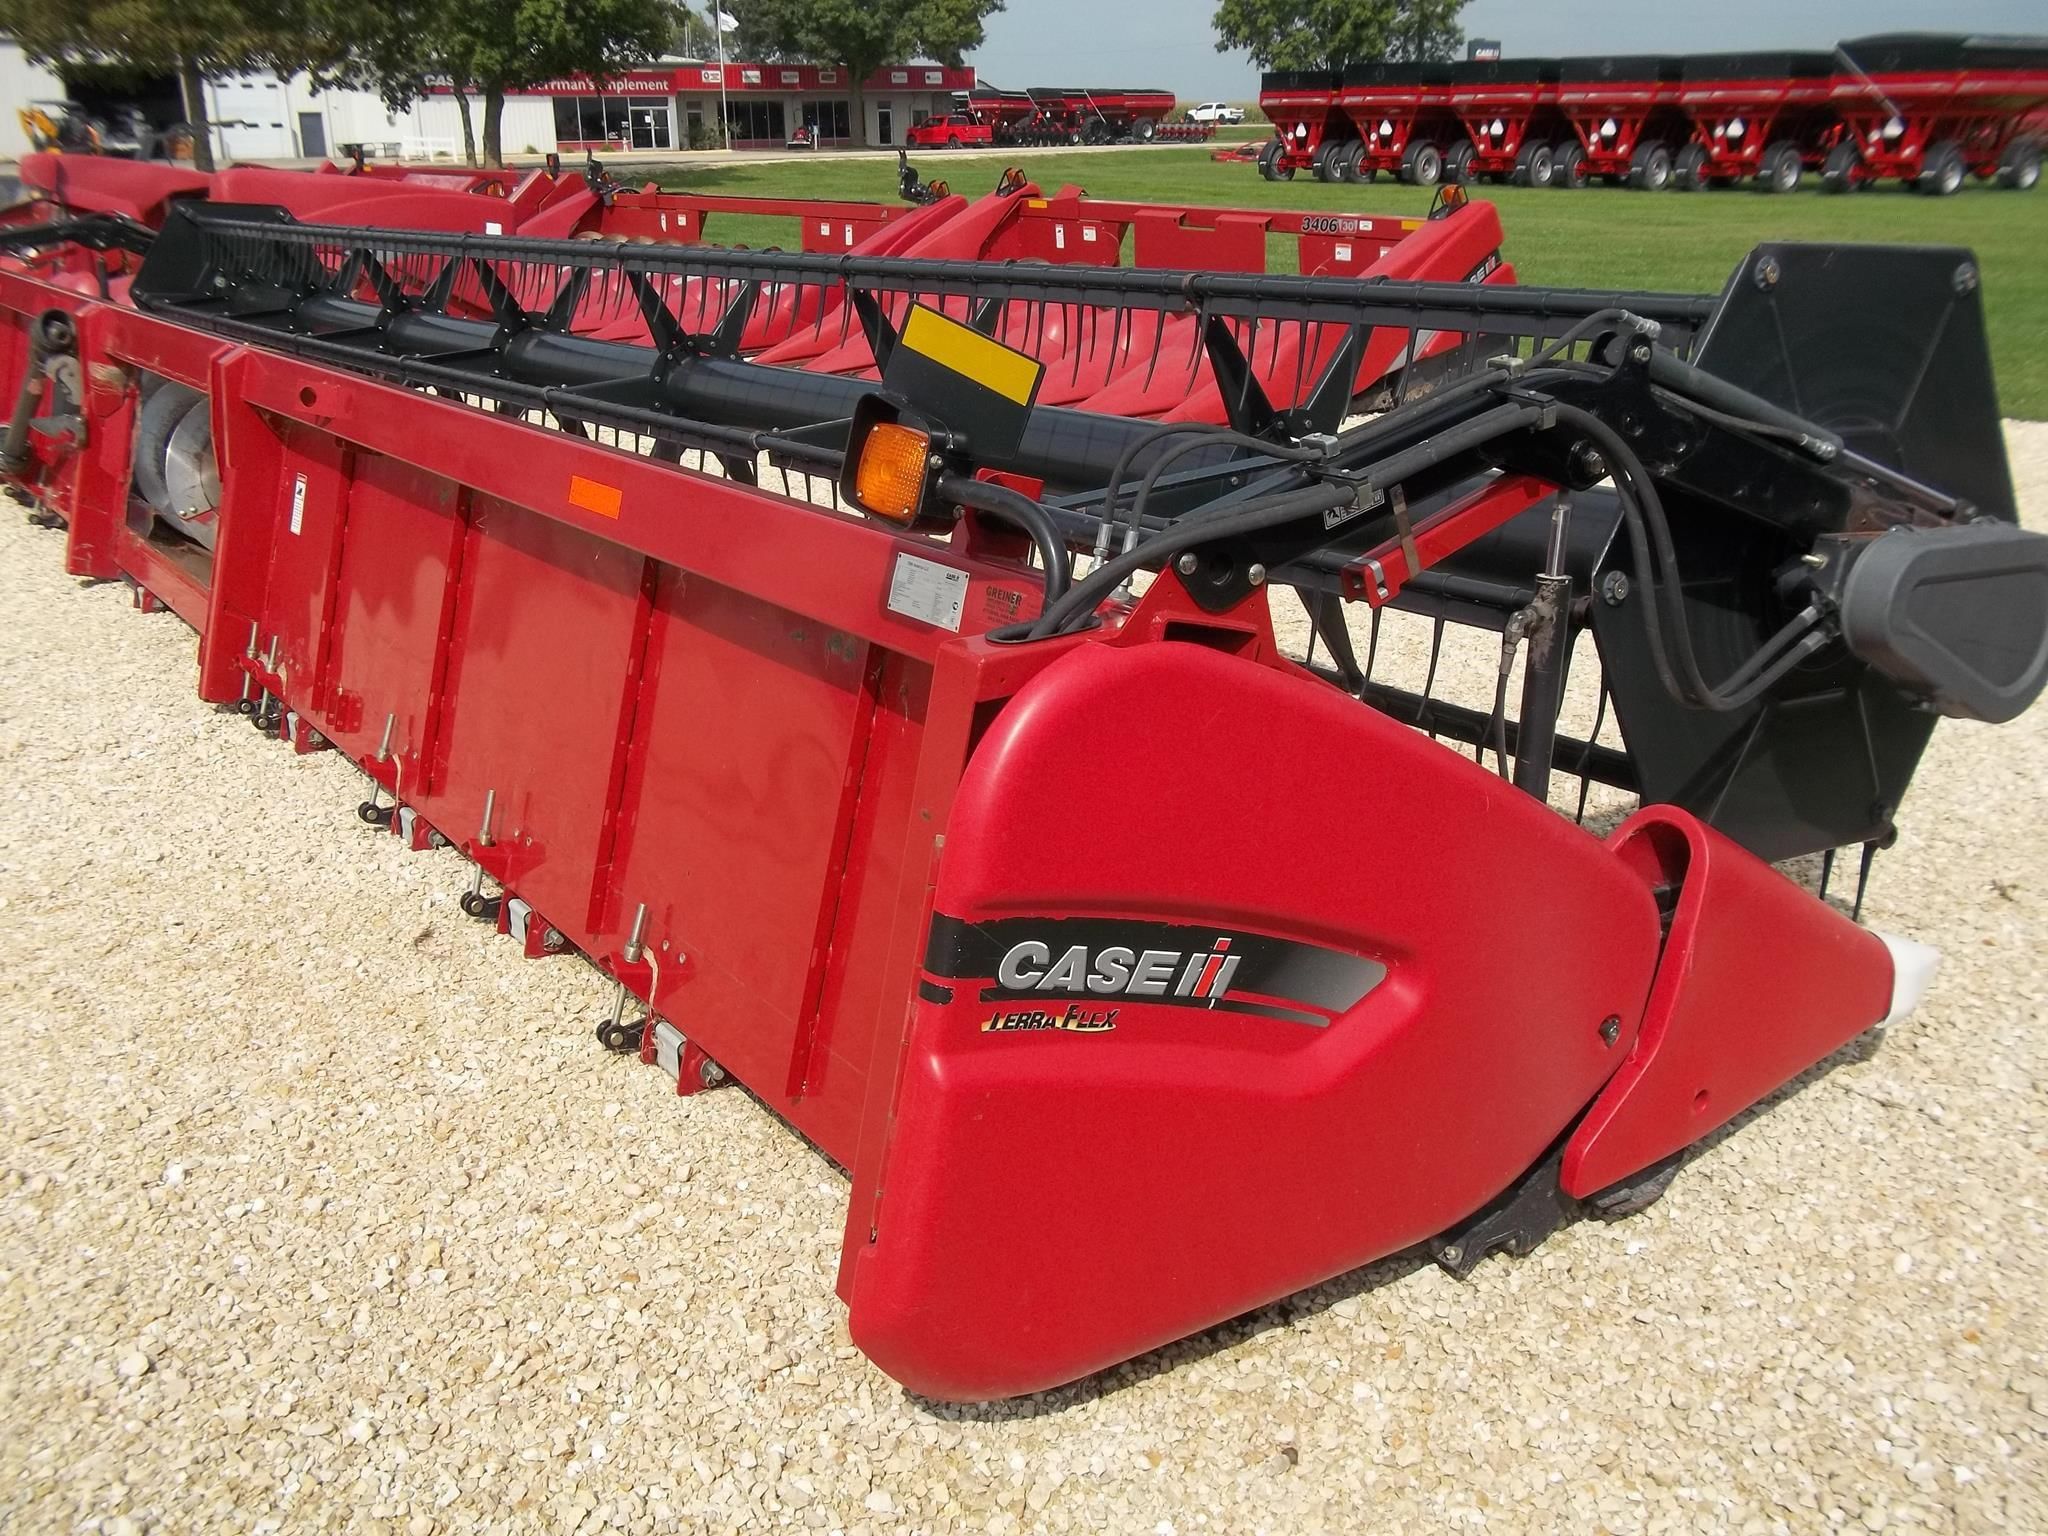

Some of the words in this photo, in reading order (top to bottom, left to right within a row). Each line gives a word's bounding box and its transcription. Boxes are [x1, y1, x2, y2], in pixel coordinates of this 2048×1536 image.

[424, 73, 455, 87] CAS
[528, 78, 595, 91] errman's
[1302, 215, 1338, 233] 3406
[1342, 220, 1354, 232] 30
[986, 585, 1023, 606] GREINER
[999, 940, 1182, 995] CASE
[1061, 1003, 1121, 1031] FLEX
